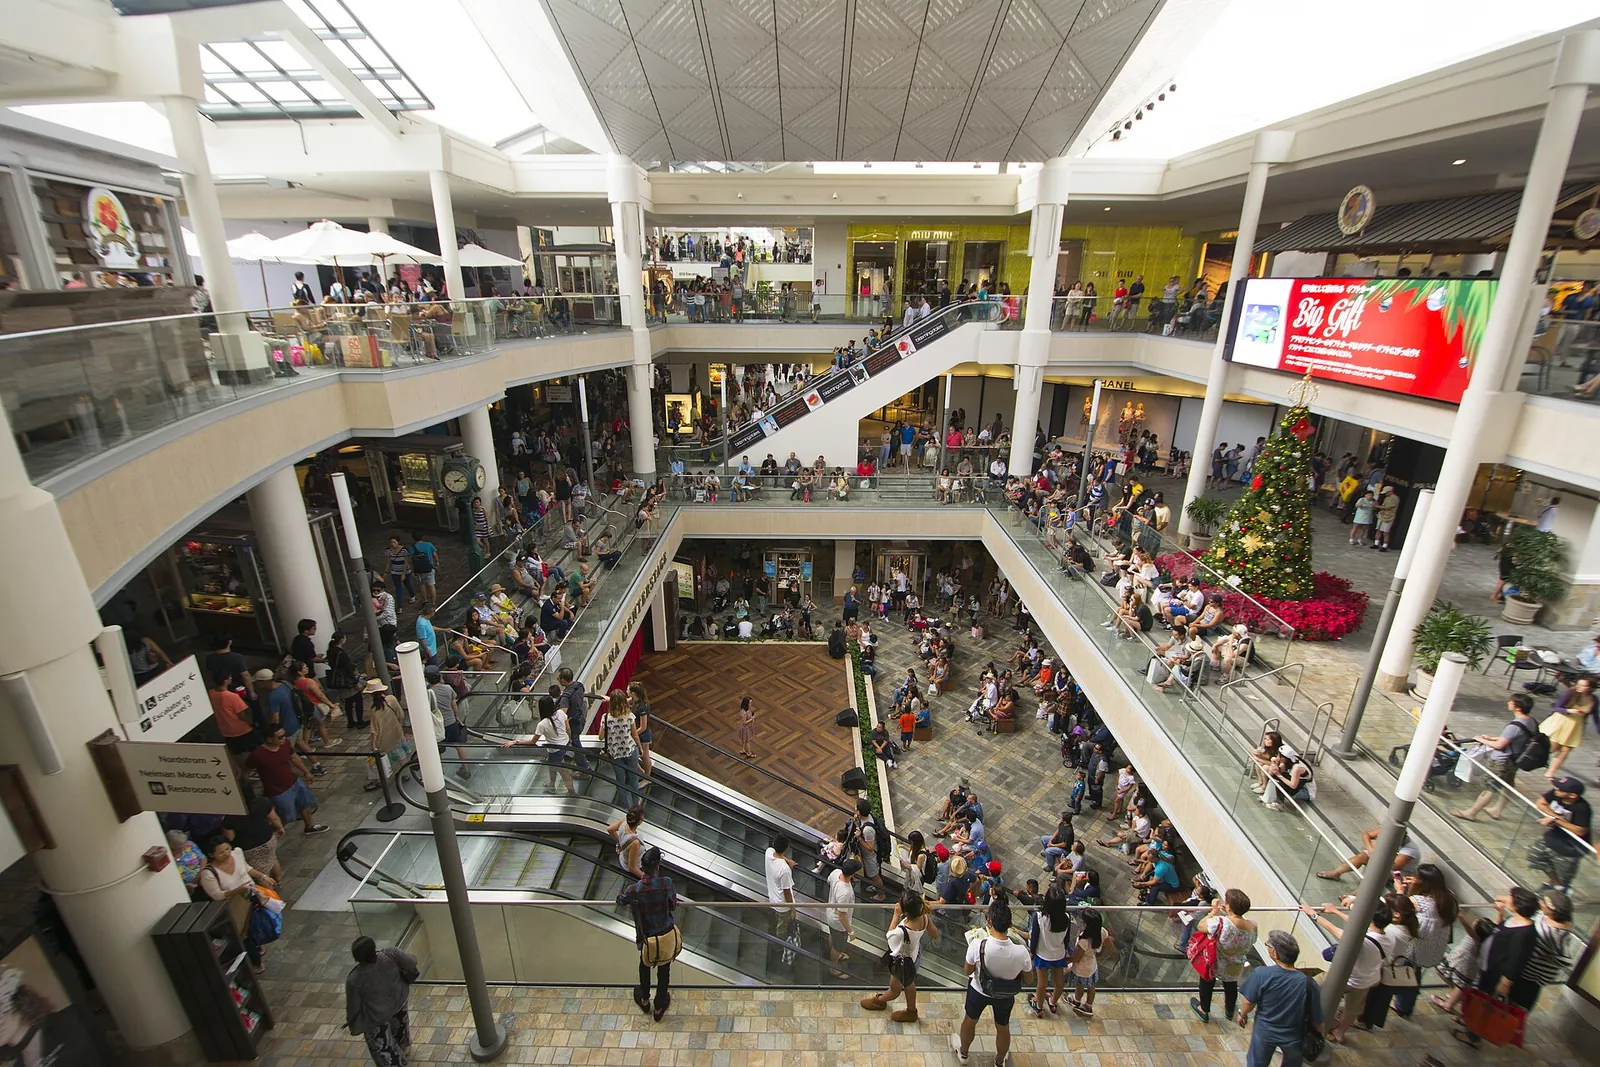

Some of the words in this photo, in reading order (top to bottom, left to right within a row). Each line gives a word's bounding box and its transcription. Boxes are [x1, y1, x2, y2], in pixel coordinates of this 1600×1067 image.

[911, 230, 931, 239] miu
[933, 230, 953, 239] miu
[1292, 297, 1326, 335] Big
[1323, 294, 1367, 338] Gift
[621, 551, 668, 642] CENTERSTAGE
[157, 680, 187, 702] Elevator
[152, 699, 182, 722] Escalator
[182, 694, 191, 702] to
[169, 704, 187, 720] Level
[158, 755, 207, 764] Nordstrom
[139, 769, 176, 778] Neiman
[177, 771, 212, 779] Marcus
[167, 784, 217, 794] Restrooms
